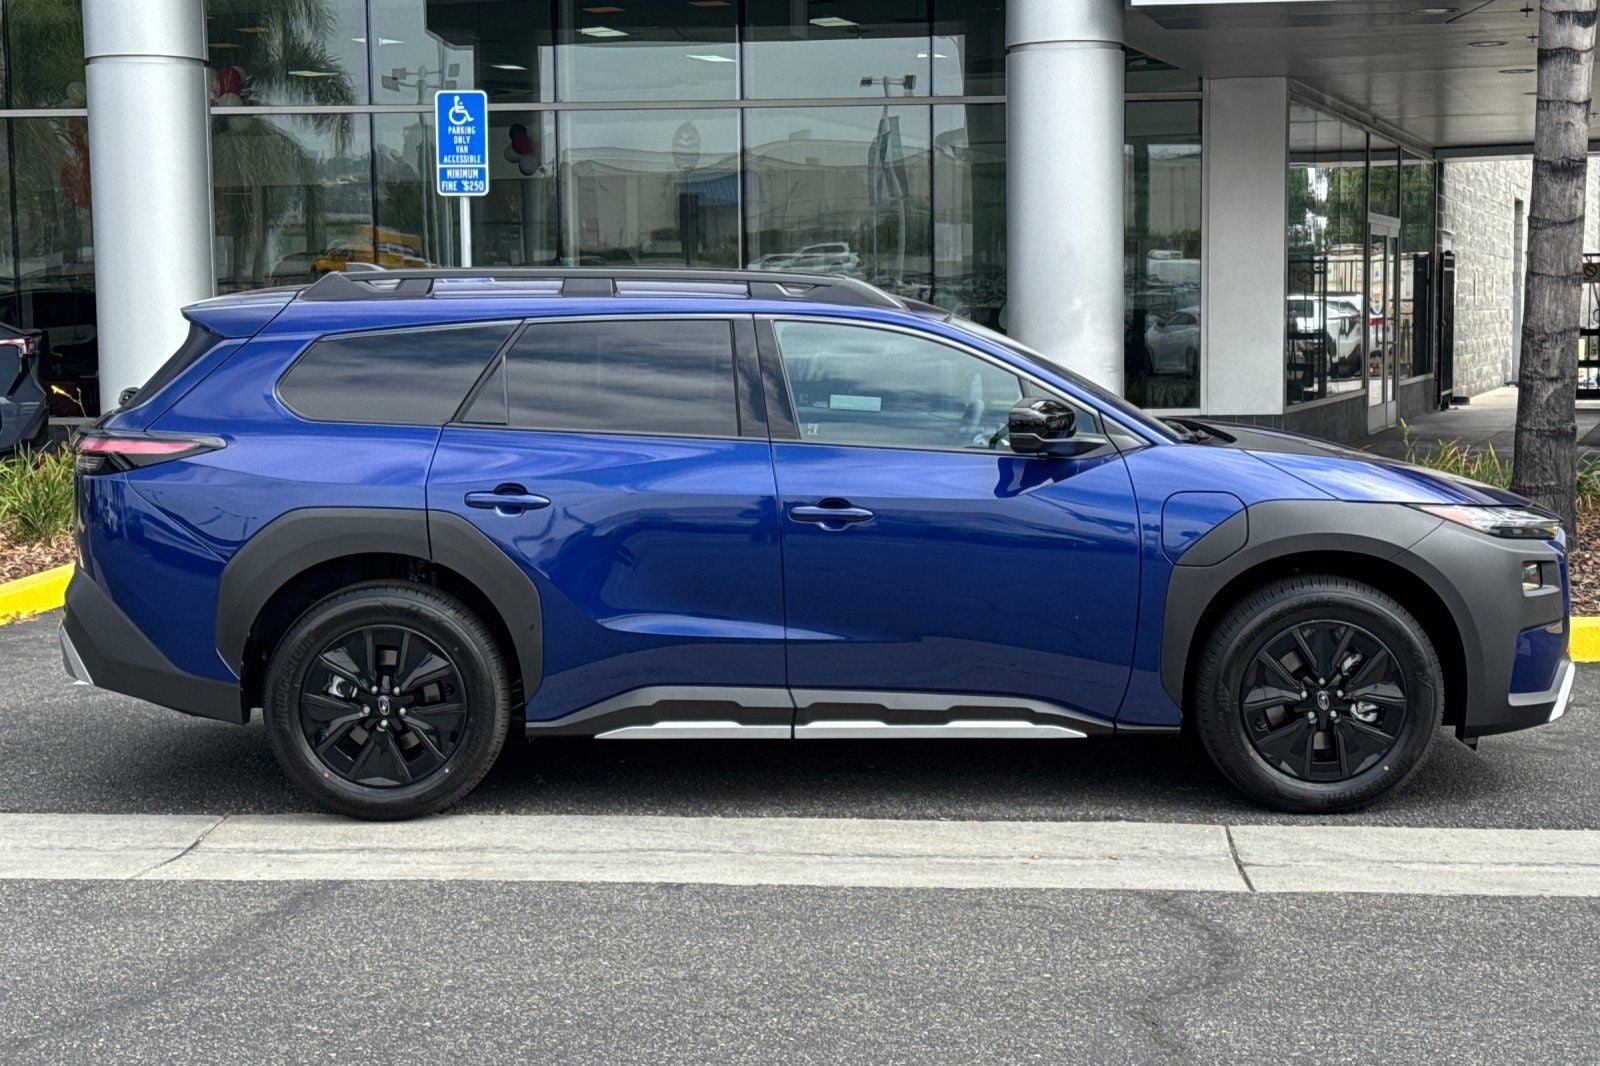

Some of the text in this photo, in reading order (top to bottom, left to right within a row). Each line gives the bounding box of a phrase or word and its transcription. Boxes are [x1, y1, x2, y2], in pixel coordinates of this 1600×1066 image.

[448, 126, 476, 135] PARKING
[453, 136, 471, 145] ONLY
[455, 145, 468, 154] VAN
[443, 155, 481, 164] ACCESSIBLE
[446, 169, 479, 179] MINIMUM
[441, 181, 484, 191] FINE $250
[275, 628, 318, 731] BRIDGESTONE
